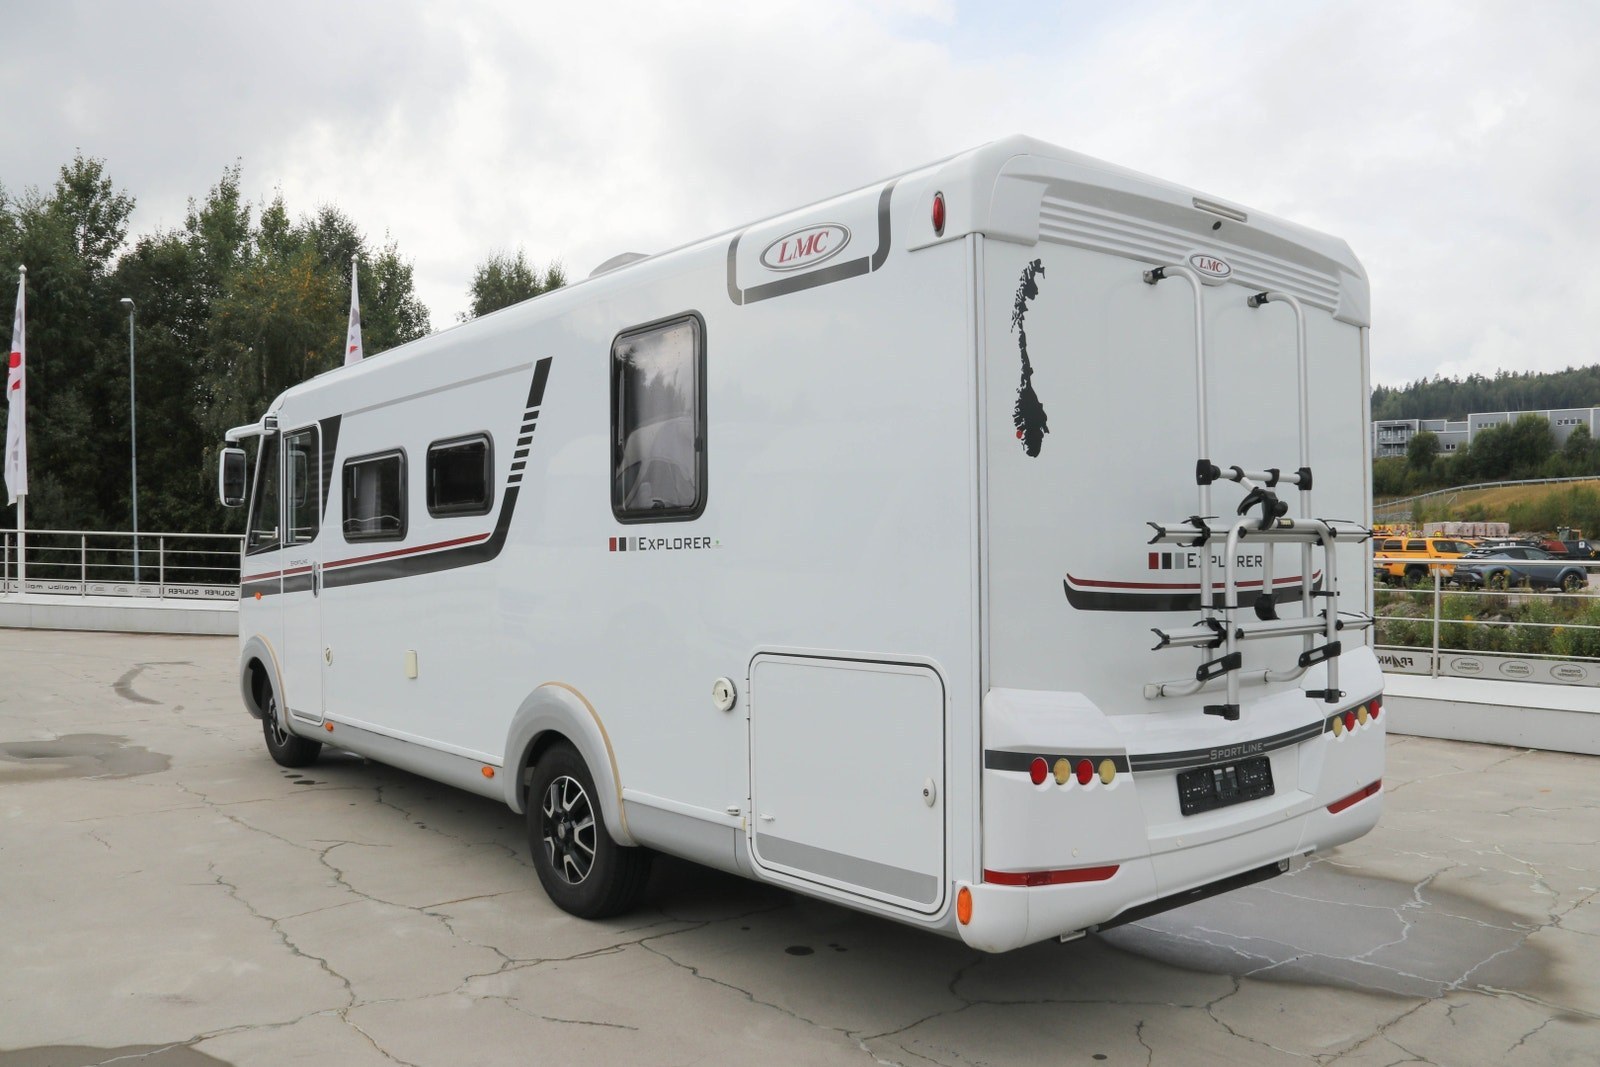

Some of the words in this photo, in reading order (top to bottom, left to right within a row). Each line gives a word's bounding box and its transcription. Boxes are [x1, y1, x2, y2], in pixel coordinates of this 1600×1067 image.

[778, 231, 829, 263] LMC
[1200, 258, 1223, 272] LMC
[639, 537, 711, 550] EXPLORER
[1187, 553, 1263, 568] EPLRER
